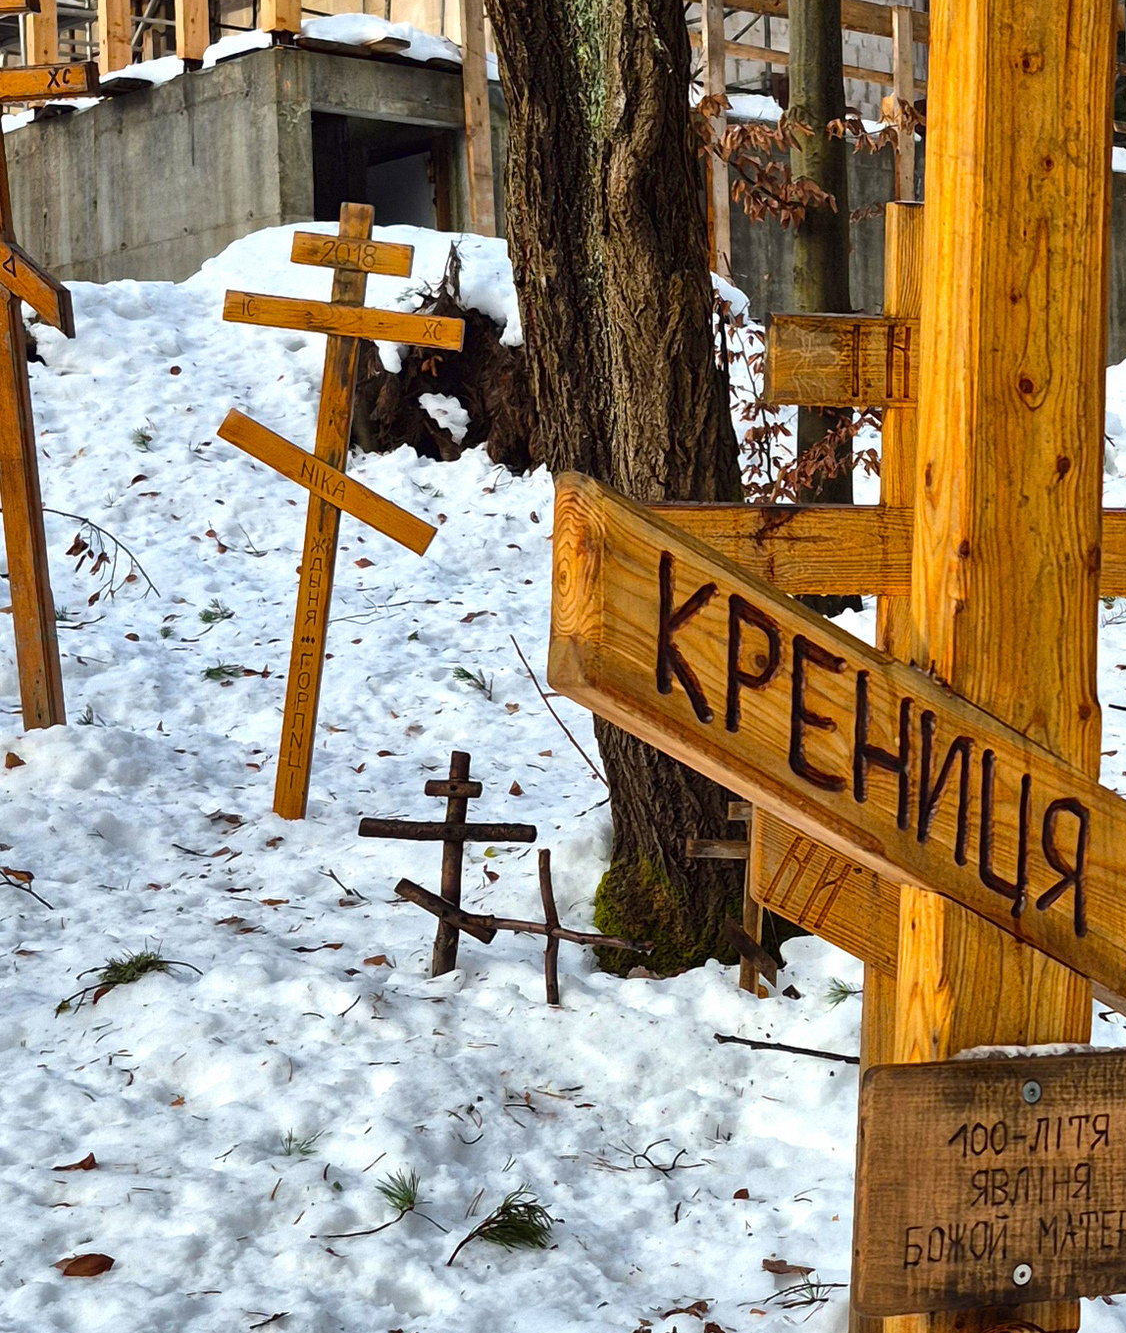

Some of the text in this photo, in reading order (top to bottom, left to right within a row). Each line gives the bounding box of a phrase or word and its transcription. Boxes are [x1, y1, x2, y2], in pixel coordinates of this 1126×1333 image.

[320, 240, 377, 268] 2018
[656, 550, 1091, 939] КРЕНИЦЯ
[947, 1113, 1110, 1158] 100-ЛІТЯ
[970, 1163, 1091, 1208] ЯВЛІНЯ
